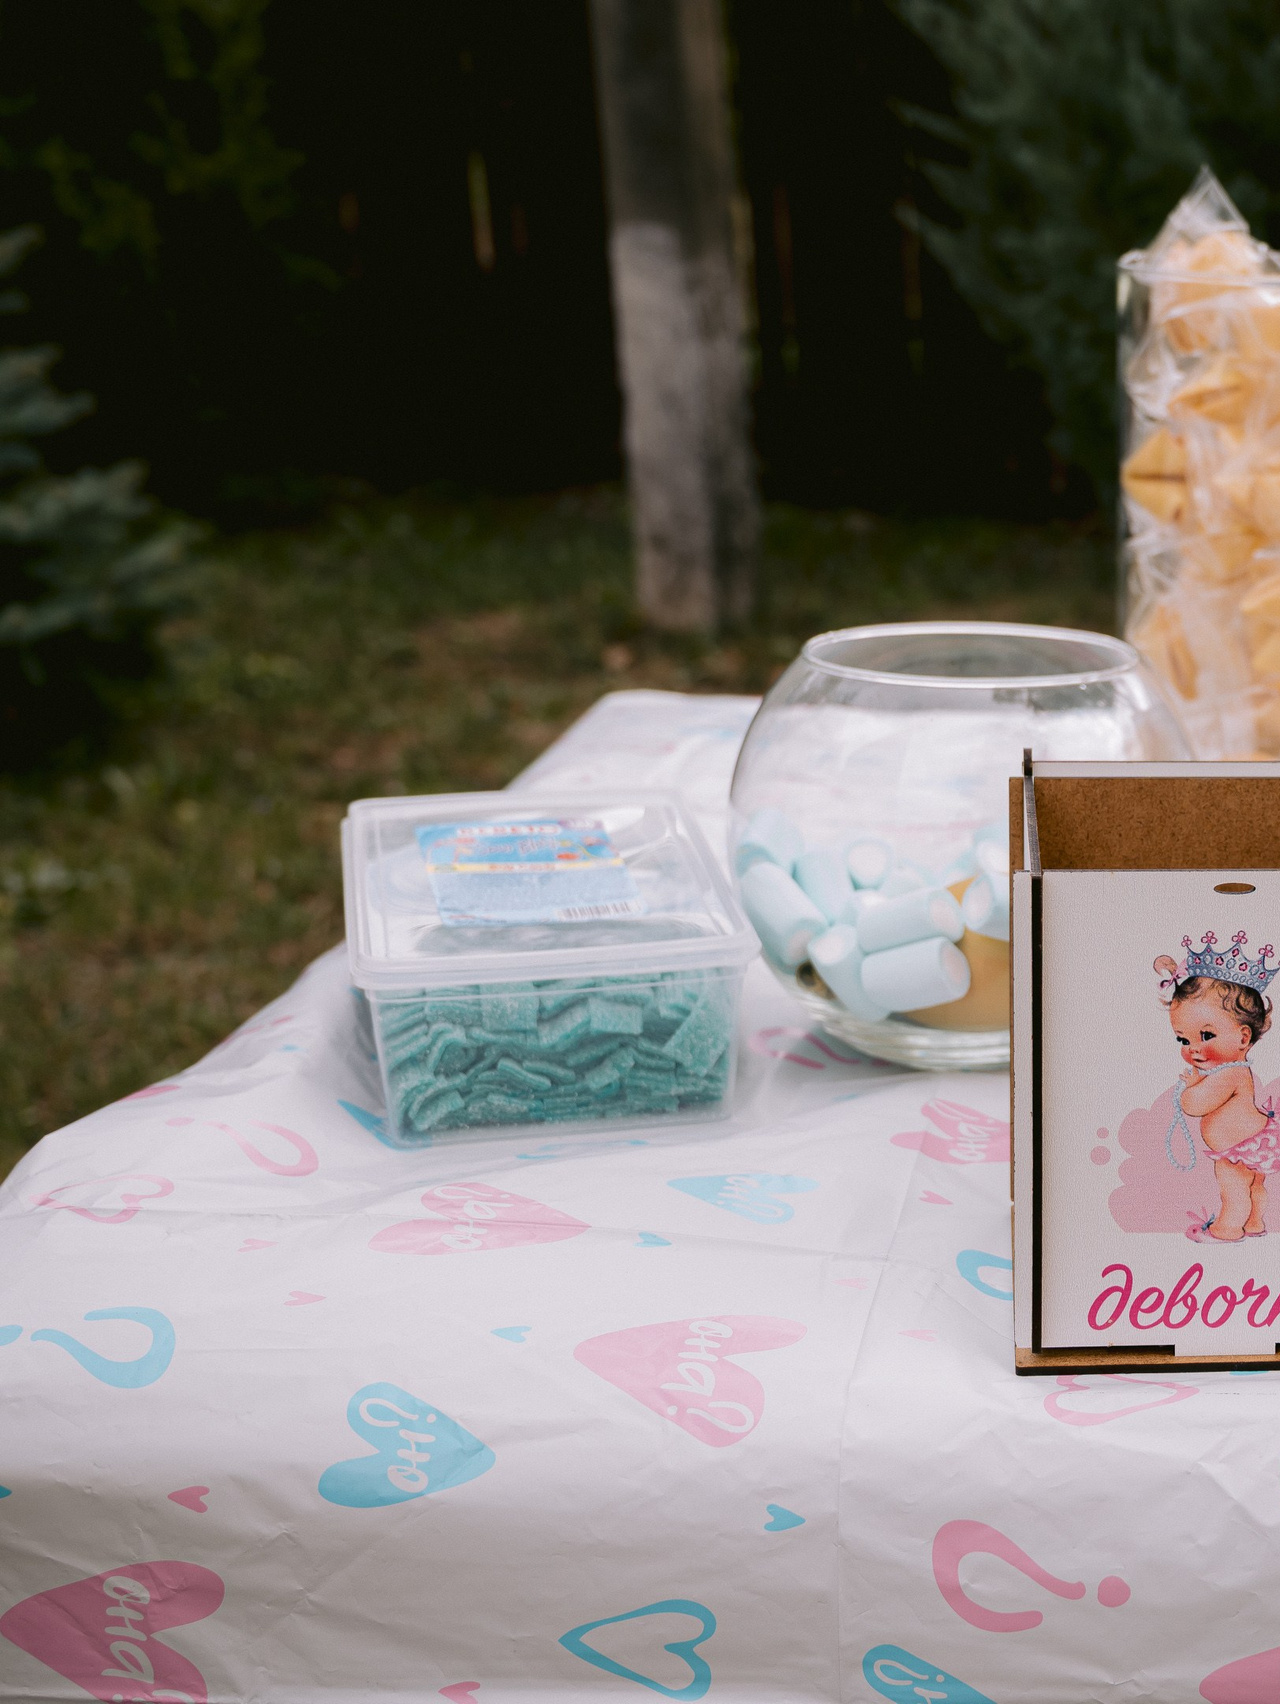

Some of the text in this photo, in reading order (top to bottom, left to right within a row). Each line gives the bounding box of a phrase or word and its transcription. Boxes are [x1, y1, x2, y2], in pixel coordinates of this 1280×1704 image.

[434, 1186, 513, 1249] она?
[659, 1320, 754, 1433] она?
[359, 1397, 437, 1493] он?
